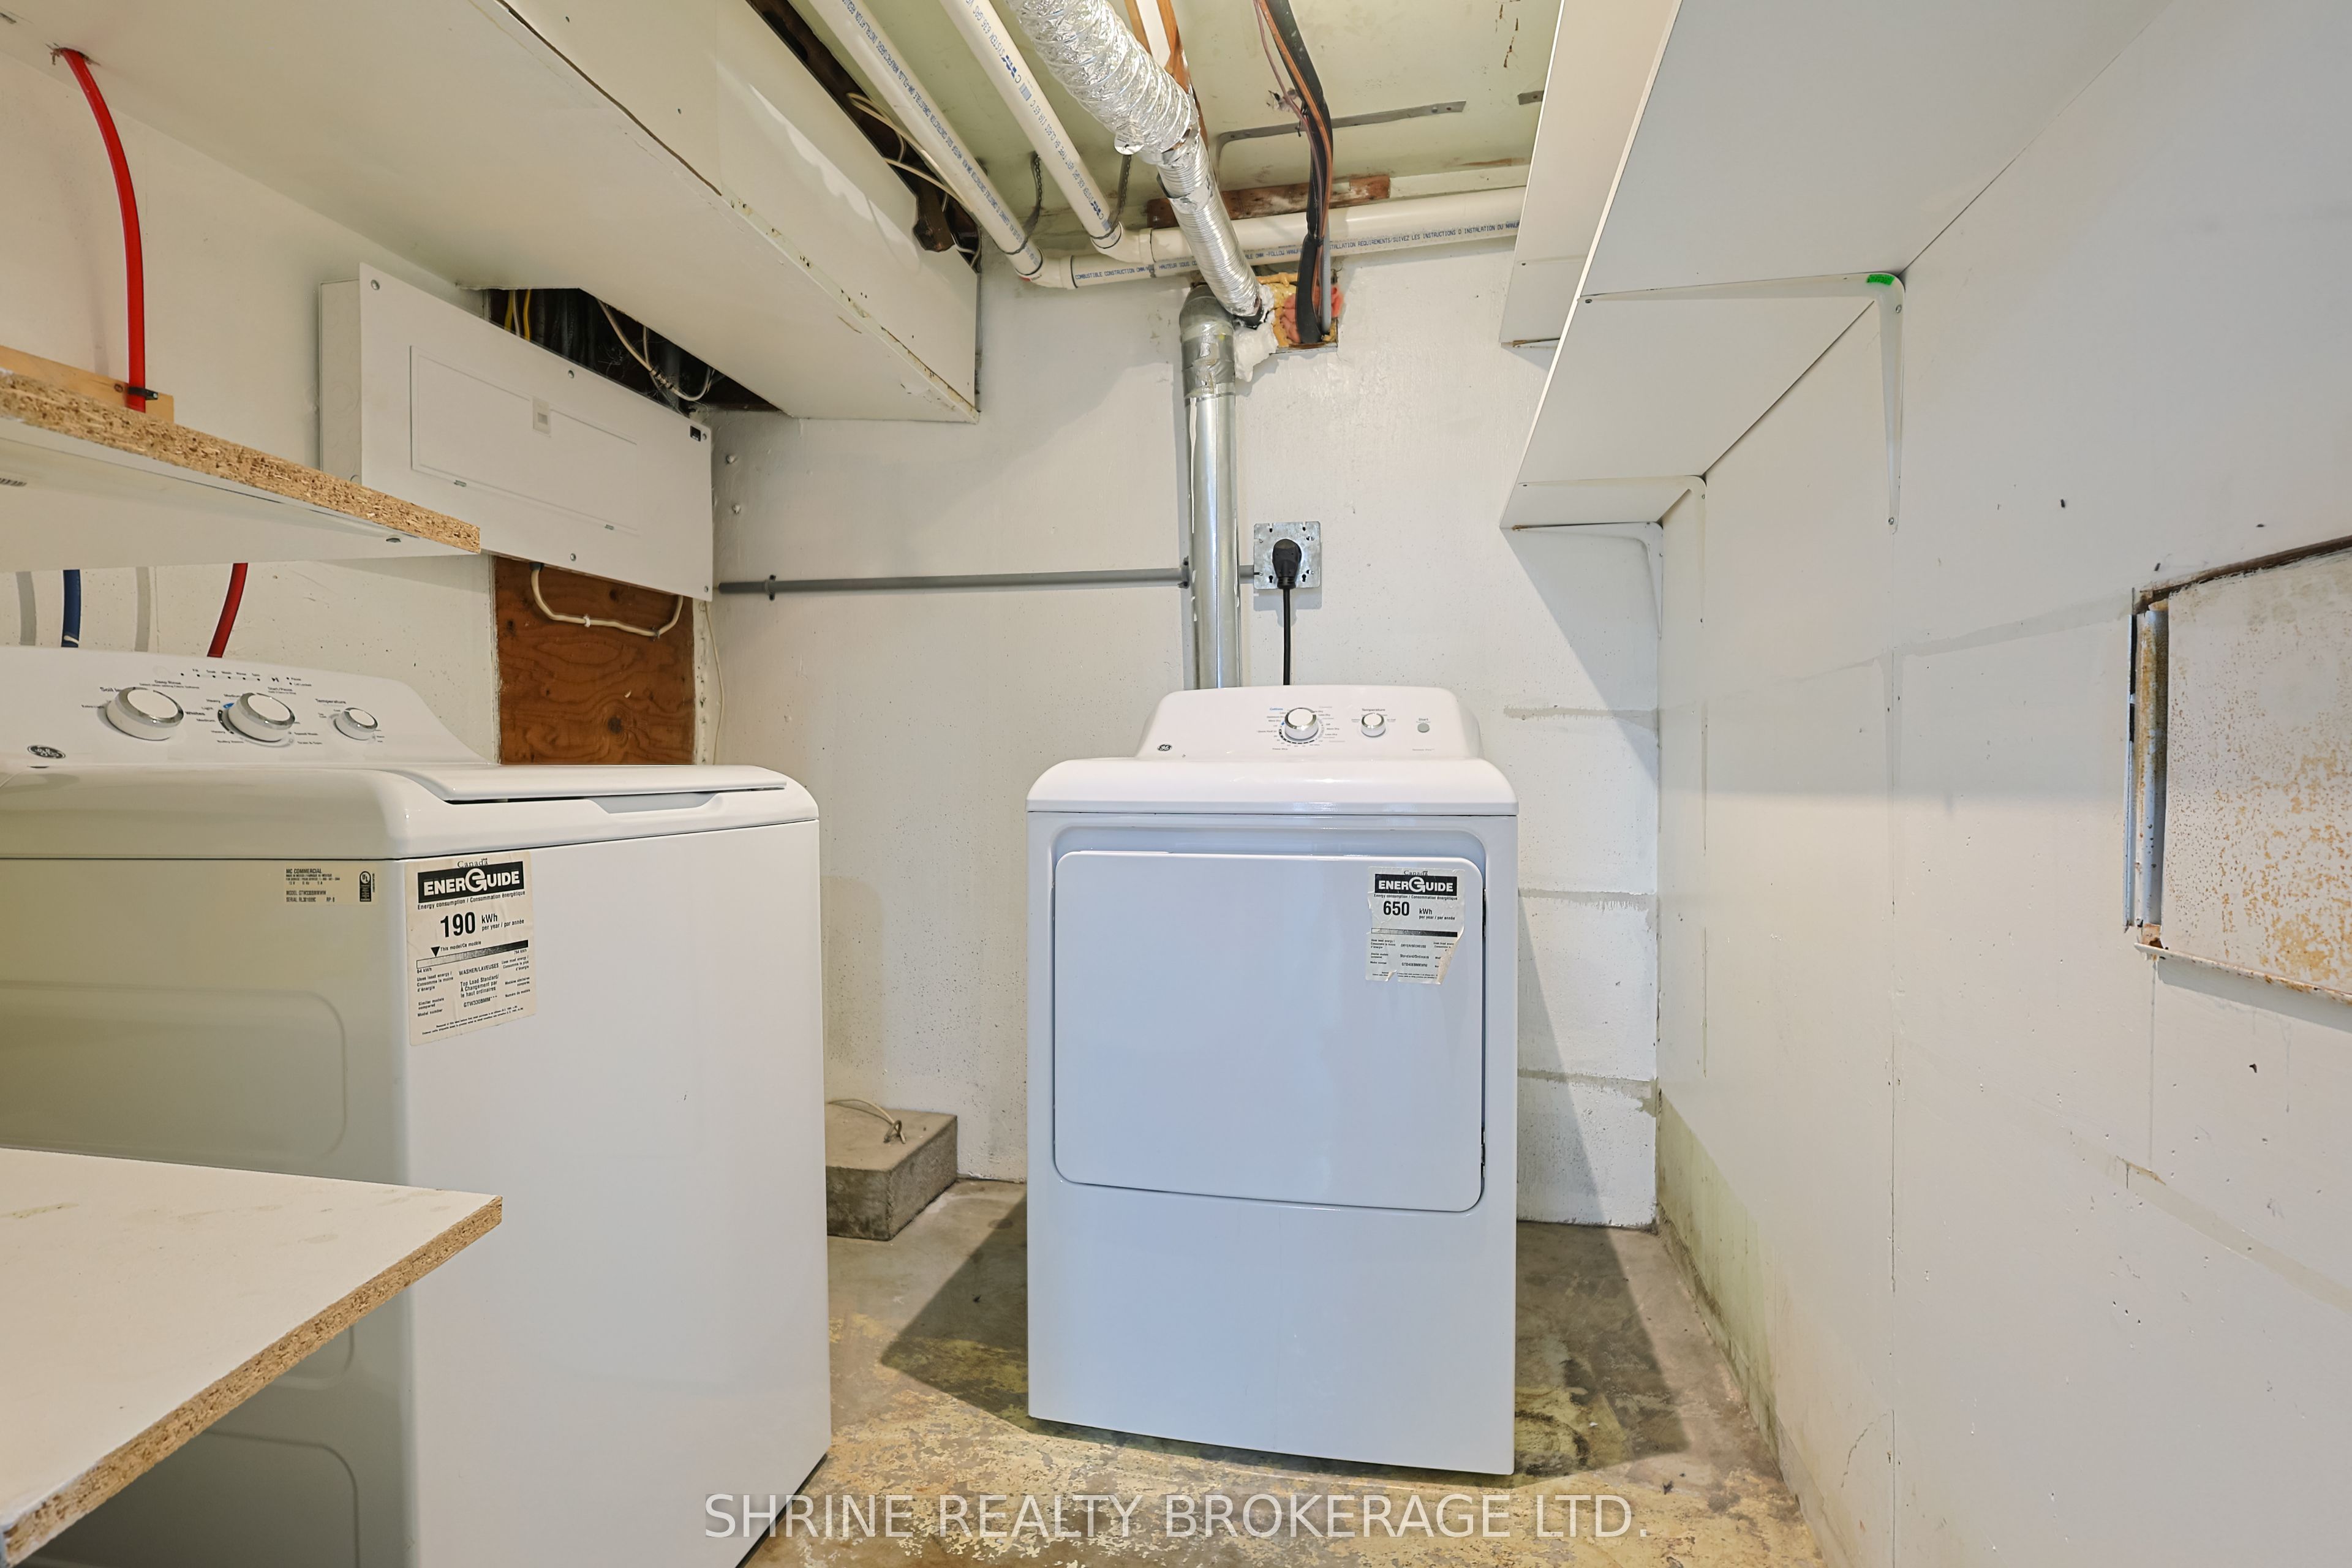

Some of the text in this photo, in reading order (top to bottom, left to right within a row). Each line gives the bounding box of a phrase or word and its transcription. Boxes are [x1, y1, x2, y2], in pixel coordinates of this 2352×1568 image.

[1422, 229, 1455, 238] INSTRUCTIONS
[1104, 268, 1134, 276] CONSTRUCTION
[457, 858, 488, 868] Canada
[424, 868, 520, 896] ENERGUIDE
[1378, 876, 1453, 892] ENERGUIDE
[436, 899, 466, 908] consumption
[470, 894, 501, 903] Consommation
[1383, 900, 1410, 916] 650
[440, 912, 475, 938] 190
[481, 913, 497, 924] kWh
[459, 963, 499, 976] WASHER/LAVEUSES
[480, 974, 499, 982] Standard/
